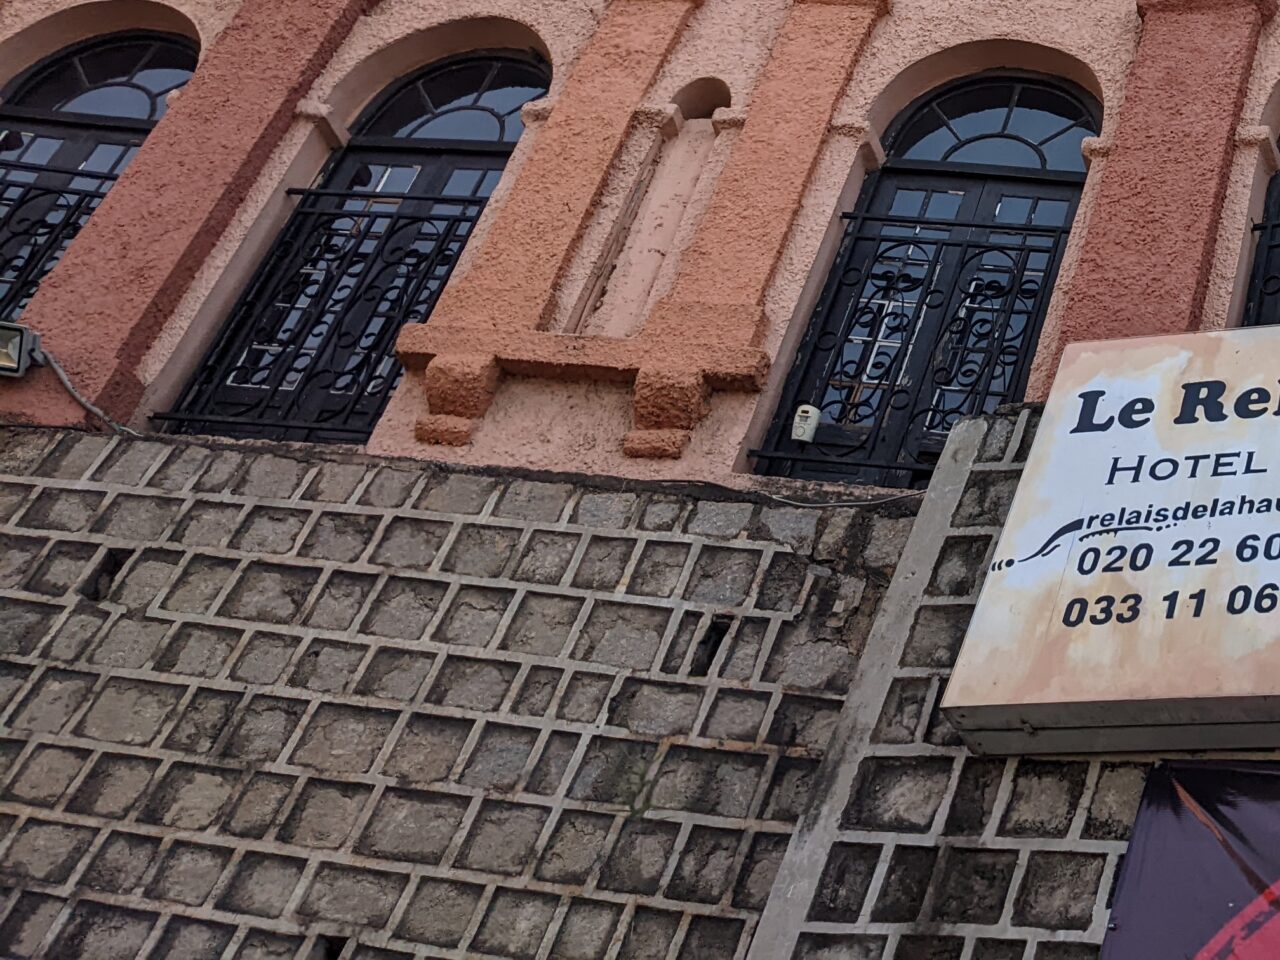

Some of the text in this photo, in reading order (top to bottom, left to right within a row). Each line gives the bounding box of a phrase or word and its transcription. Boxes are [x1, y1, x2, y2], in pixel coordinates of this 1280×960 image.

[1069, 390, 1155, 434] Le
[1105, 451, 1268, 486] HOTEL
[1077, 543, 1153, 576] 020
[1169, 537, 1219, 566] 22
[1062, 594, 1141, 628] 033
[1162, 589, 1206, 619] 11
